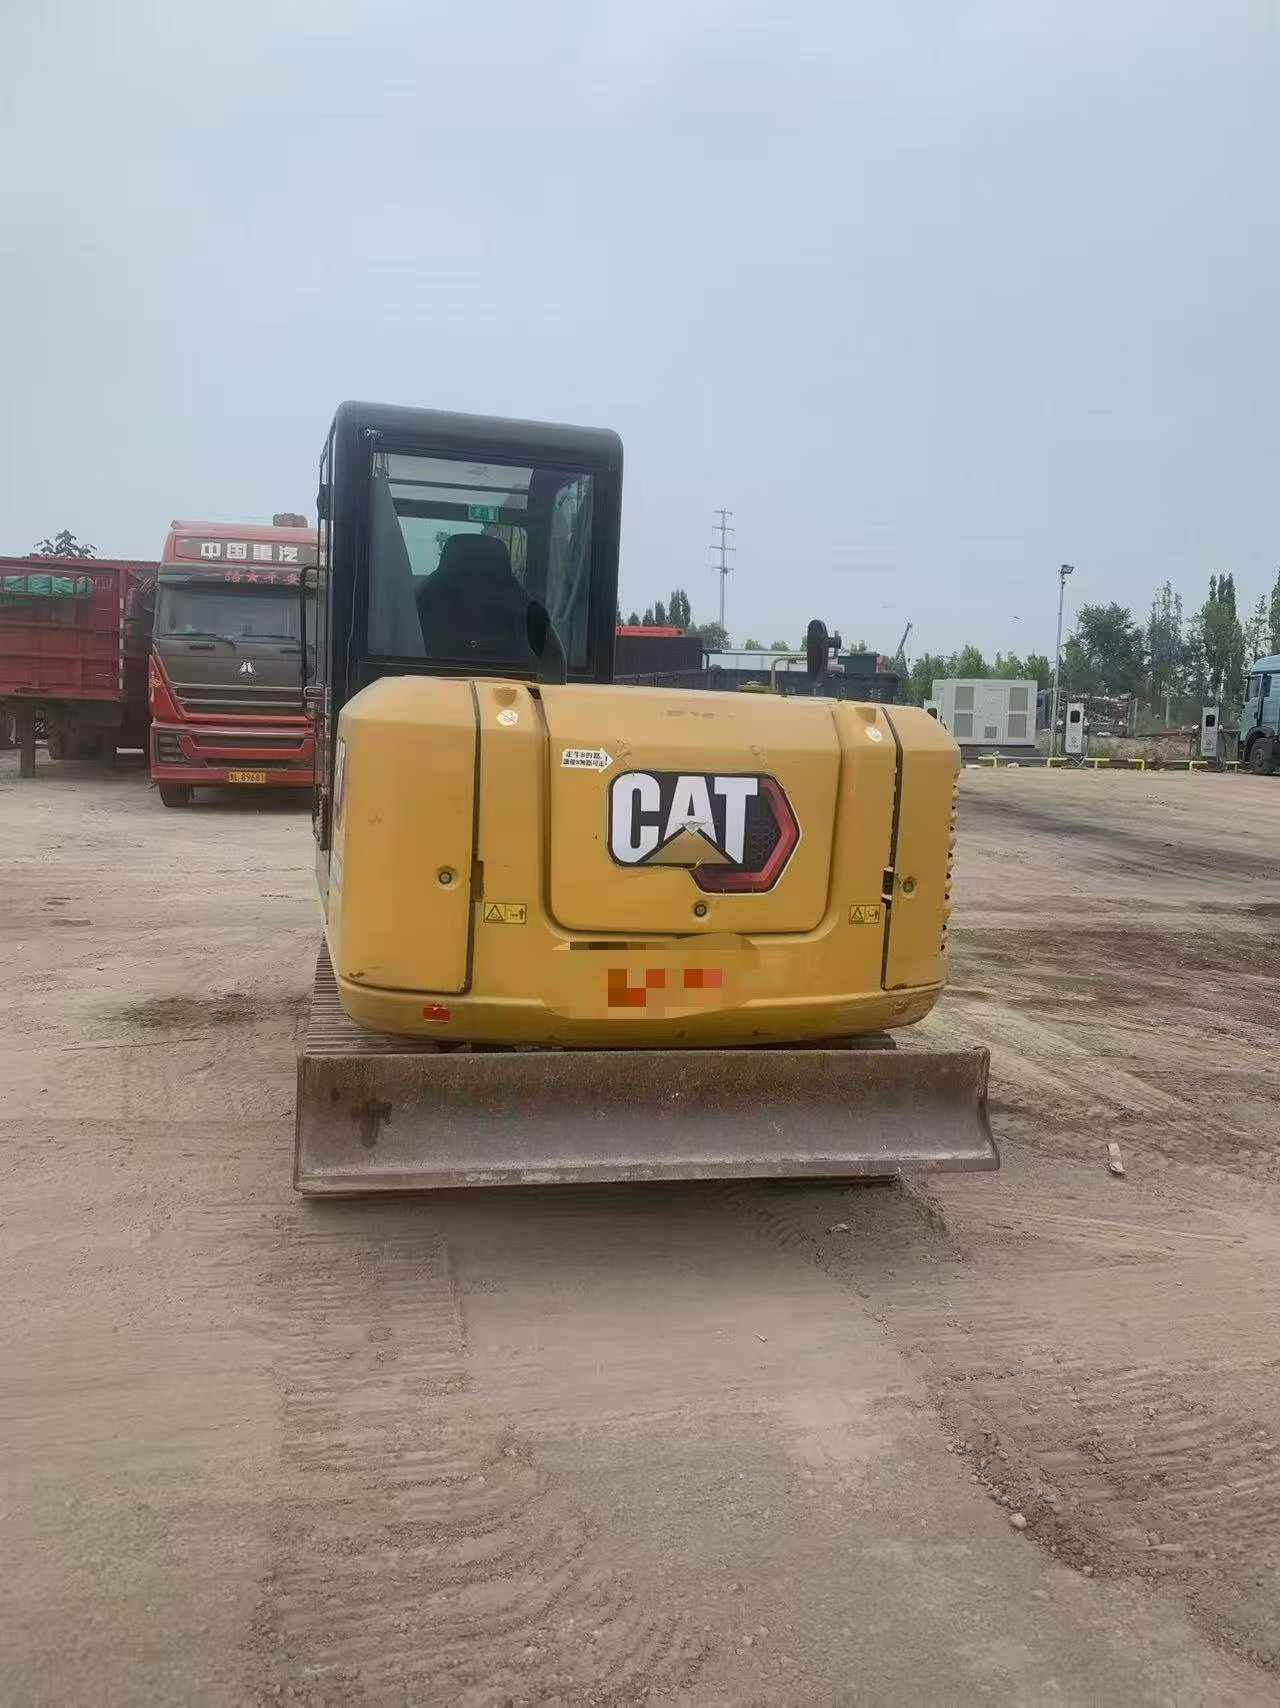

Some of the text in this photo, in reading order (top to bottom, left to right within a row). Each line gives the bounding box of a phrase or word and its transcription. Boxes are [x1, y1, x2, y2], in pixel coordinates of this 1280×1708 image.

[201, 541, 298, 562] 中国重汽
[612, 773, 758, 865] CAT
